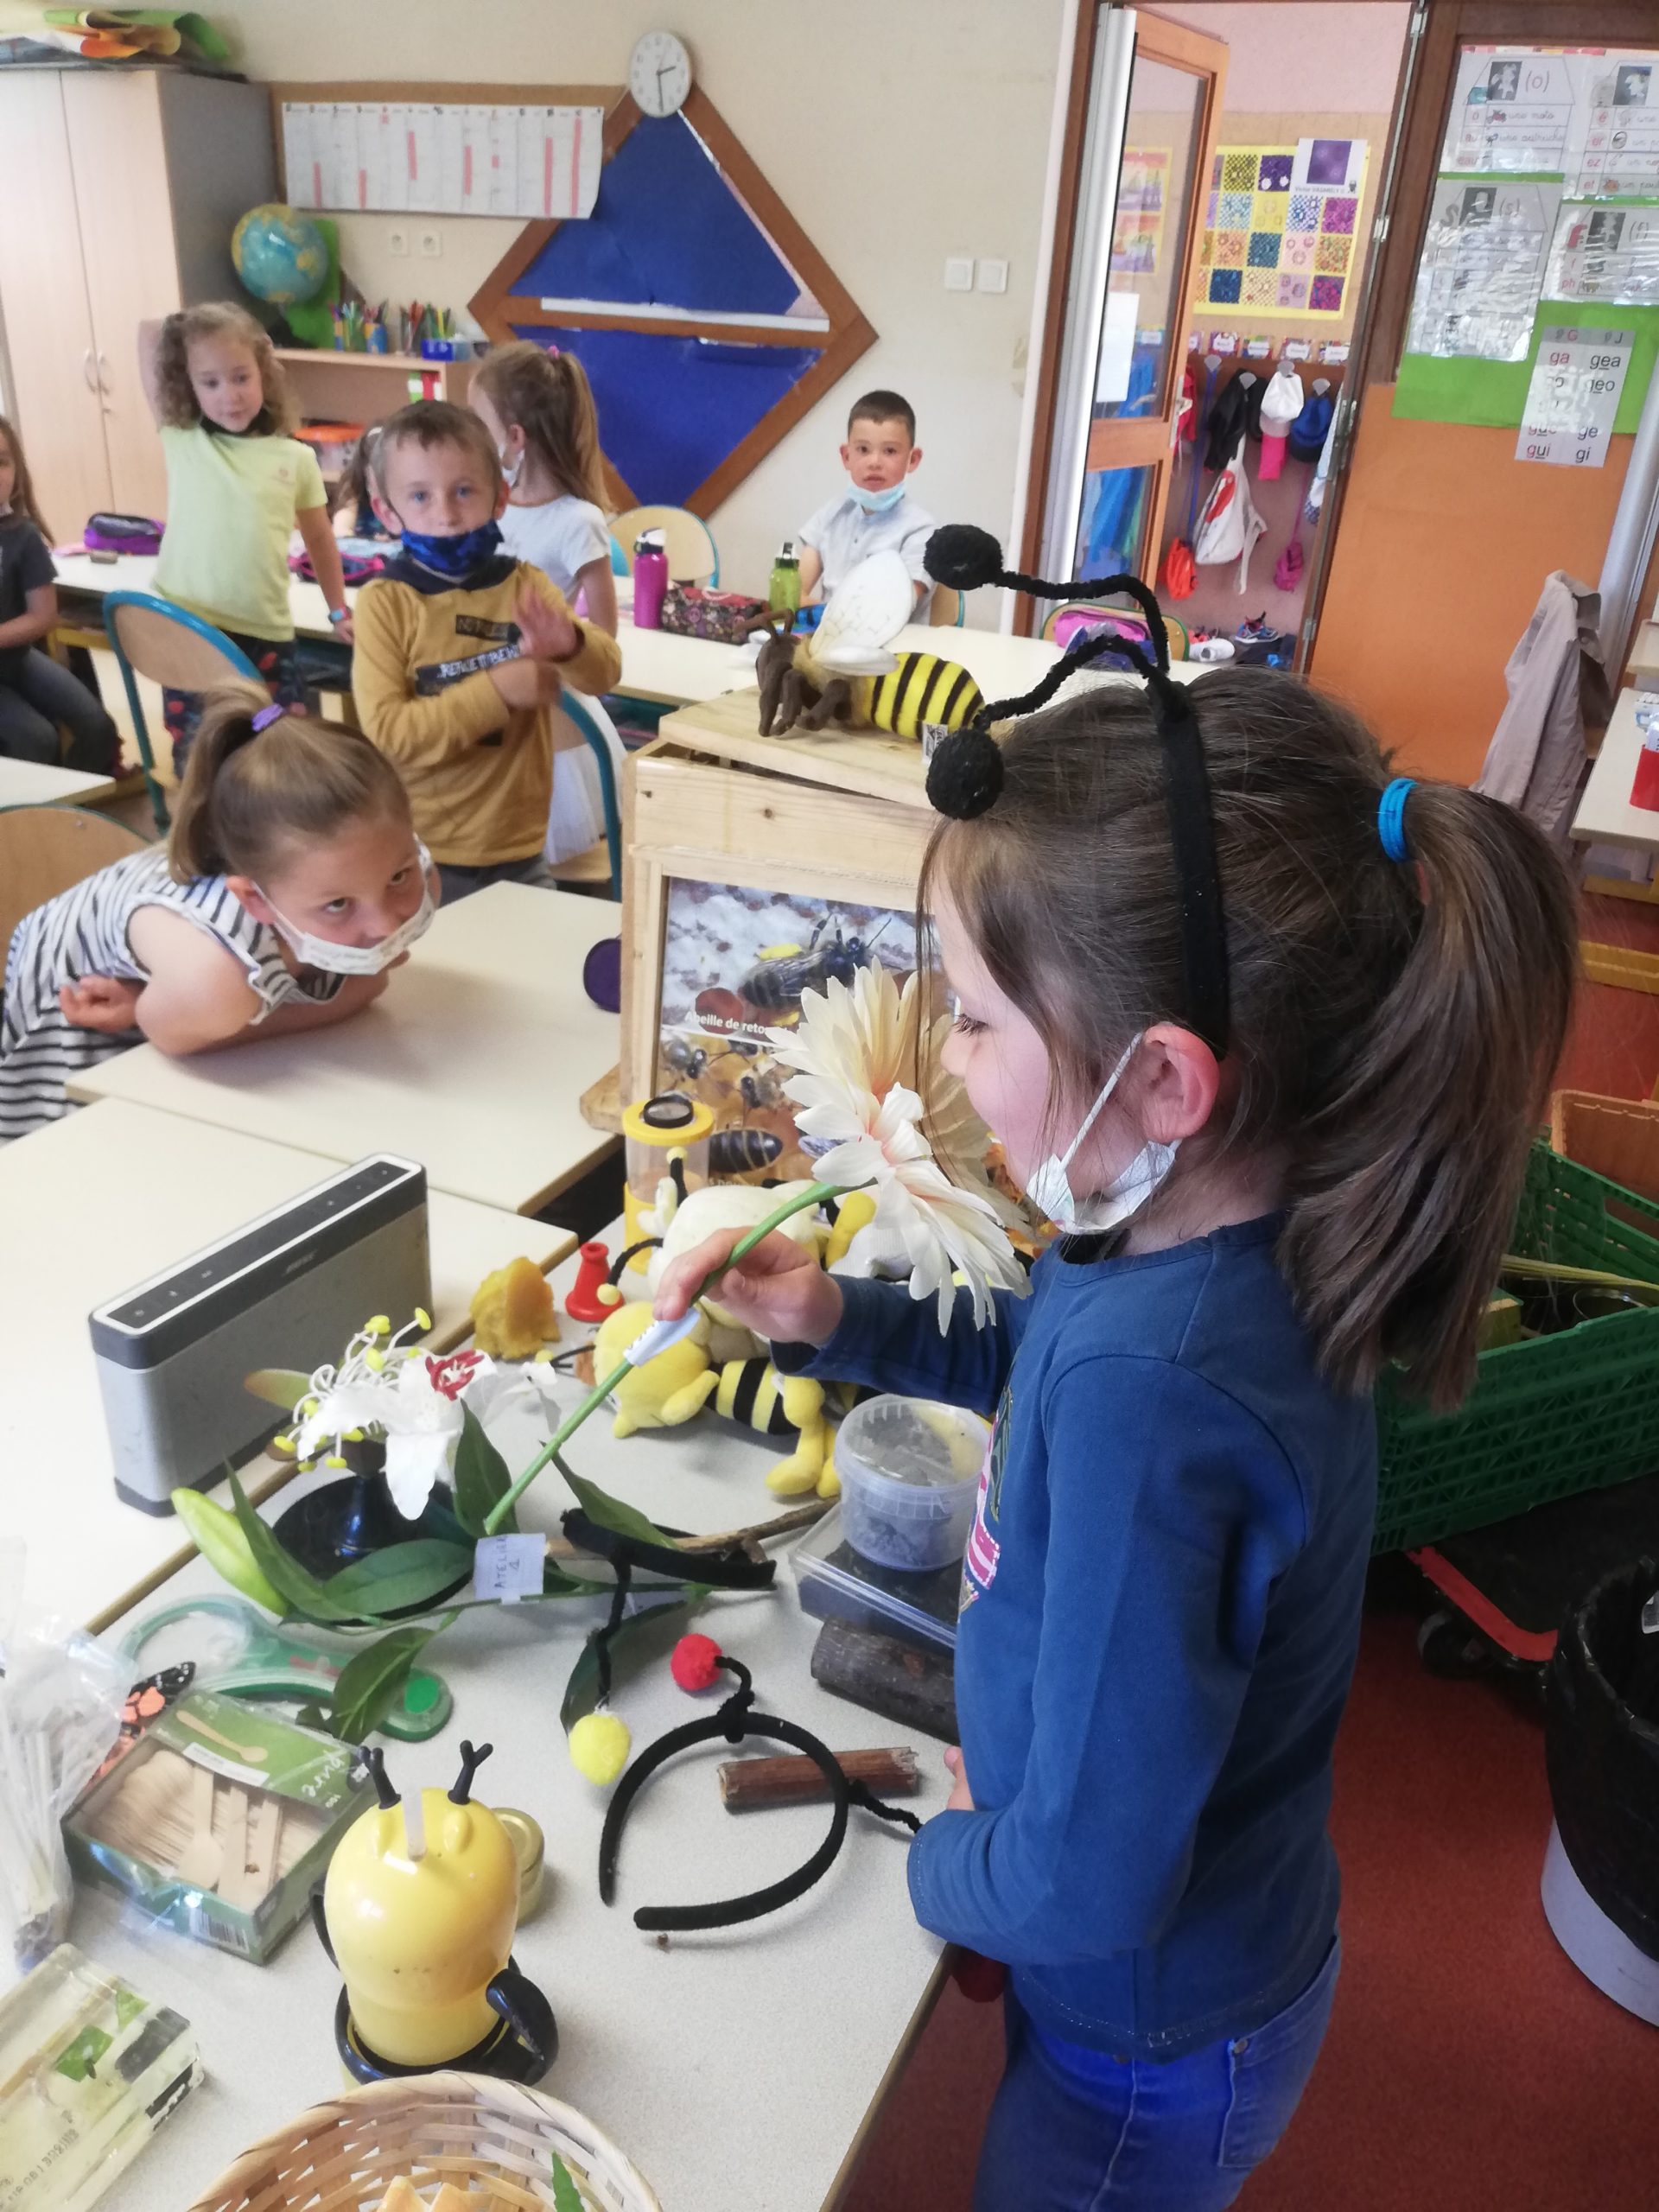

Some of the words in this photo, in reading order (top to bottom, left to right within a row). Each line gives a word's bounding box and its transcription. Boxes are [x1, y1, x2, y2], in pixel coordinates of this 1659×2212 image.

[1550, 352, 1570, 366] ga
[1590, 354, 1622, 371] gea
[1527, 443, 1551, 460] gui
[1575, 447, 1592, 463] gi
[685, 1010, 724, 1028] Abeille
[725, 1018, 741, 1031] de
[742, 1022, 768, 1035] reto
